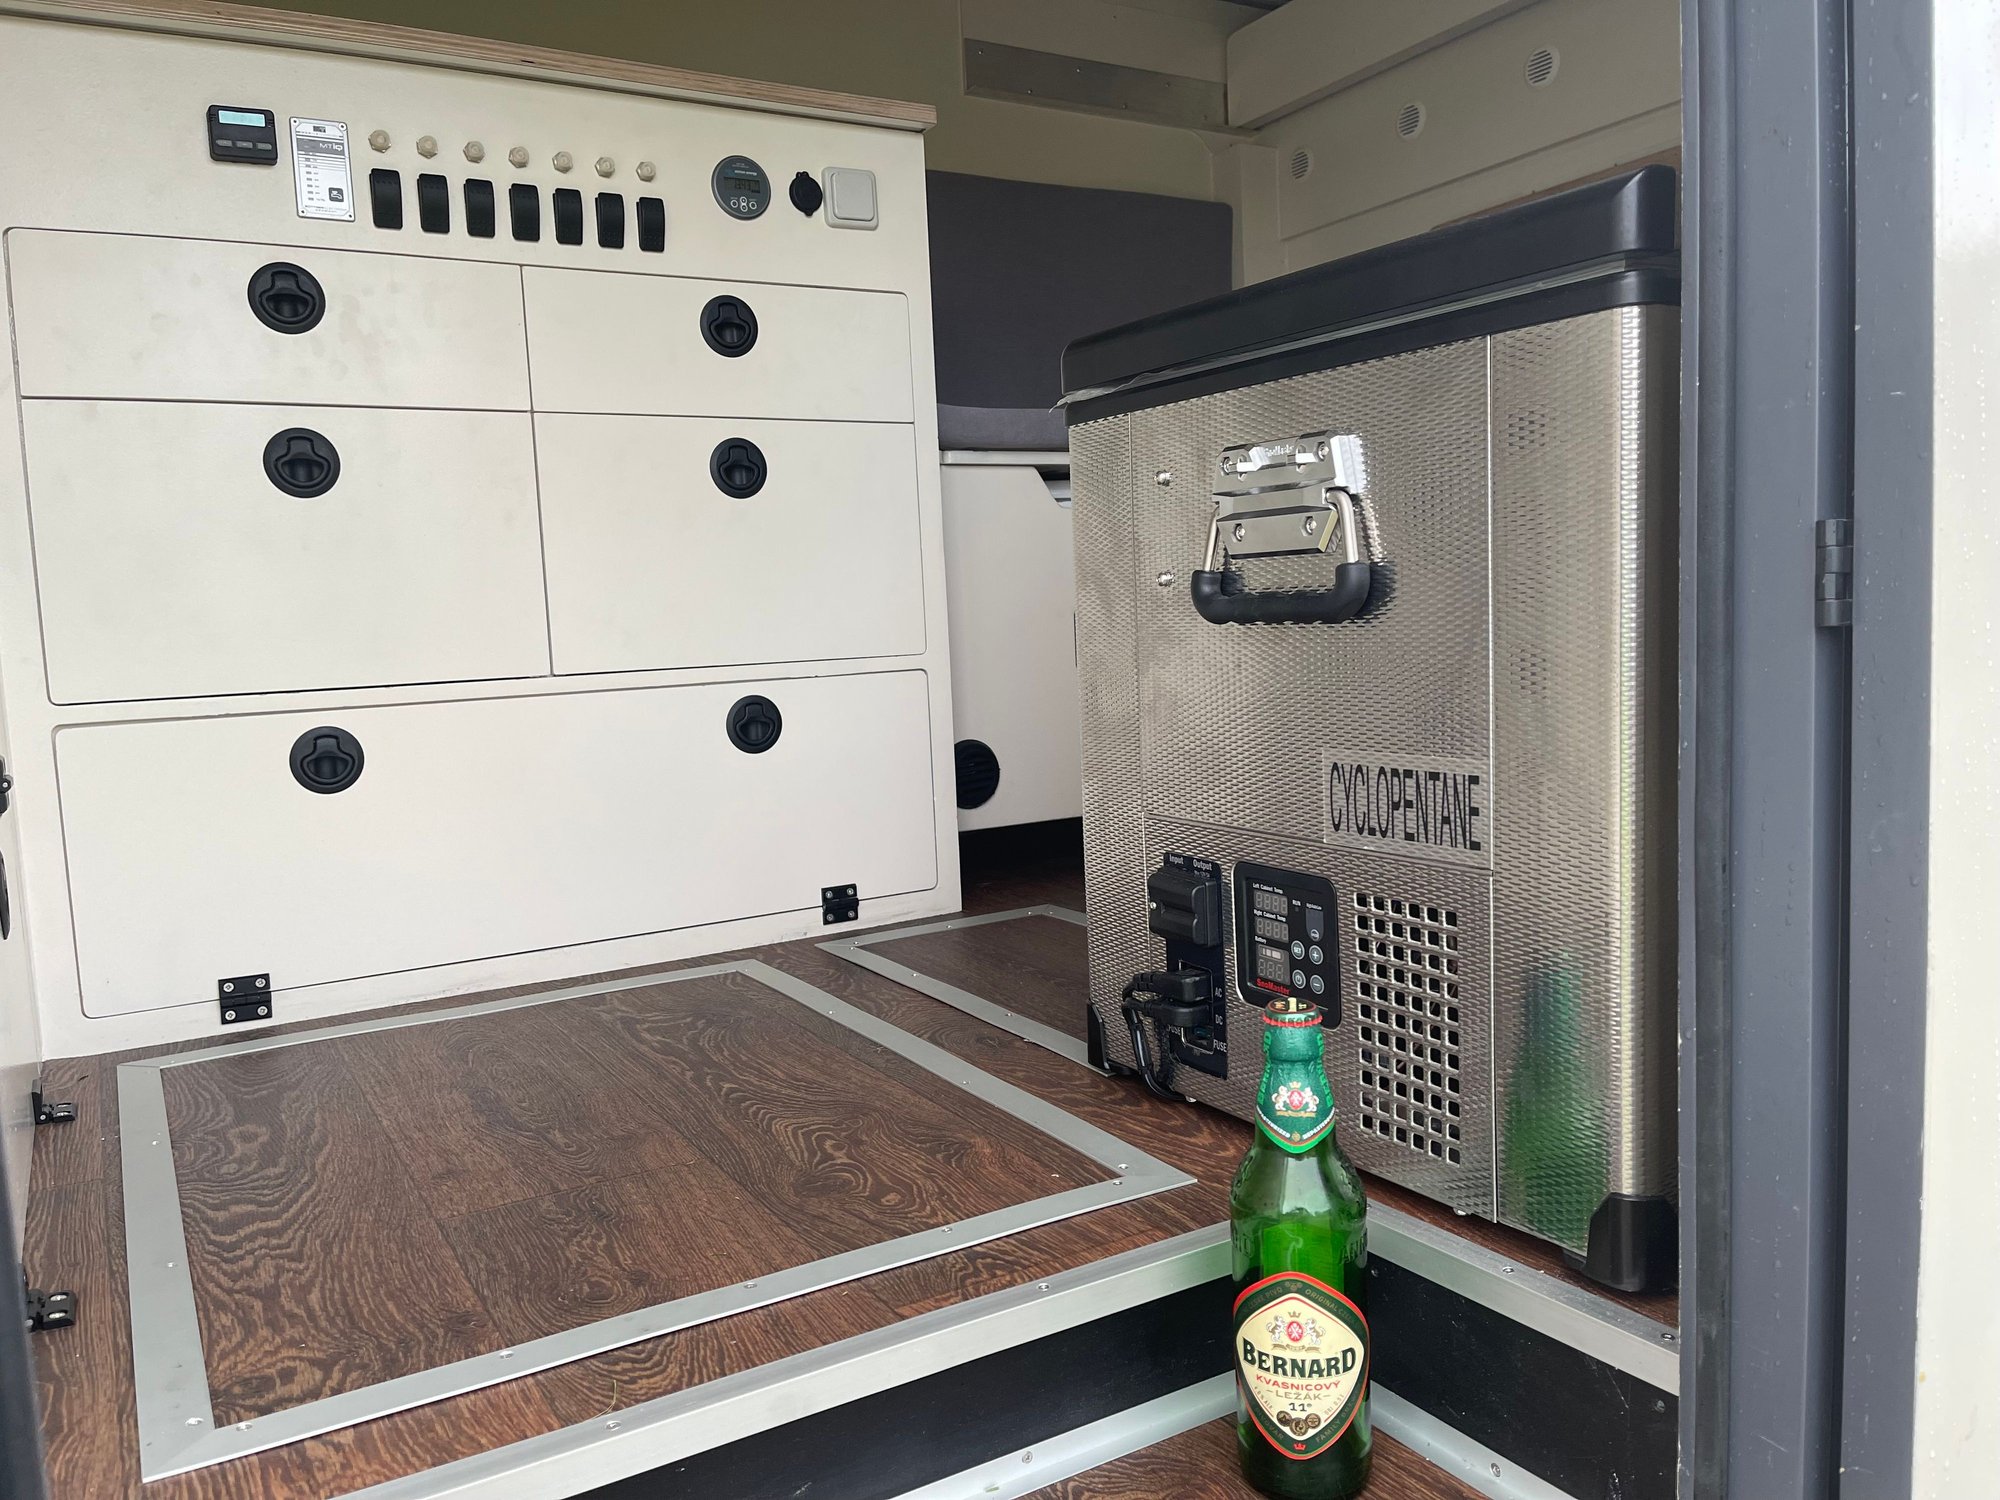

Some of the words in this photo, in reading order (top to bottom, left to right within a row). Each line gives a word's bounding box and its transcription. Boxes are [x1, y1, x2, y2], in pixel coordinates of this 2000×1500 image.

[1330, 761, 1481, 851] CYCLOPENTANE
[1169, 853, 1184, 865] Input
[1193, 858, 1213, 871] Output
[1214, 986, 1223, 999] AC
[1214, 1013, 1224, 1026] DC
[1213, 1038, 1227, 1053] FUSE
[1305, 1288, 1337, 1312] ORIGINAL
[1242, 1336, 1357, 1379] BERNARD
[1256, 1374, 1341, 1392] KVASNICOVÝ
